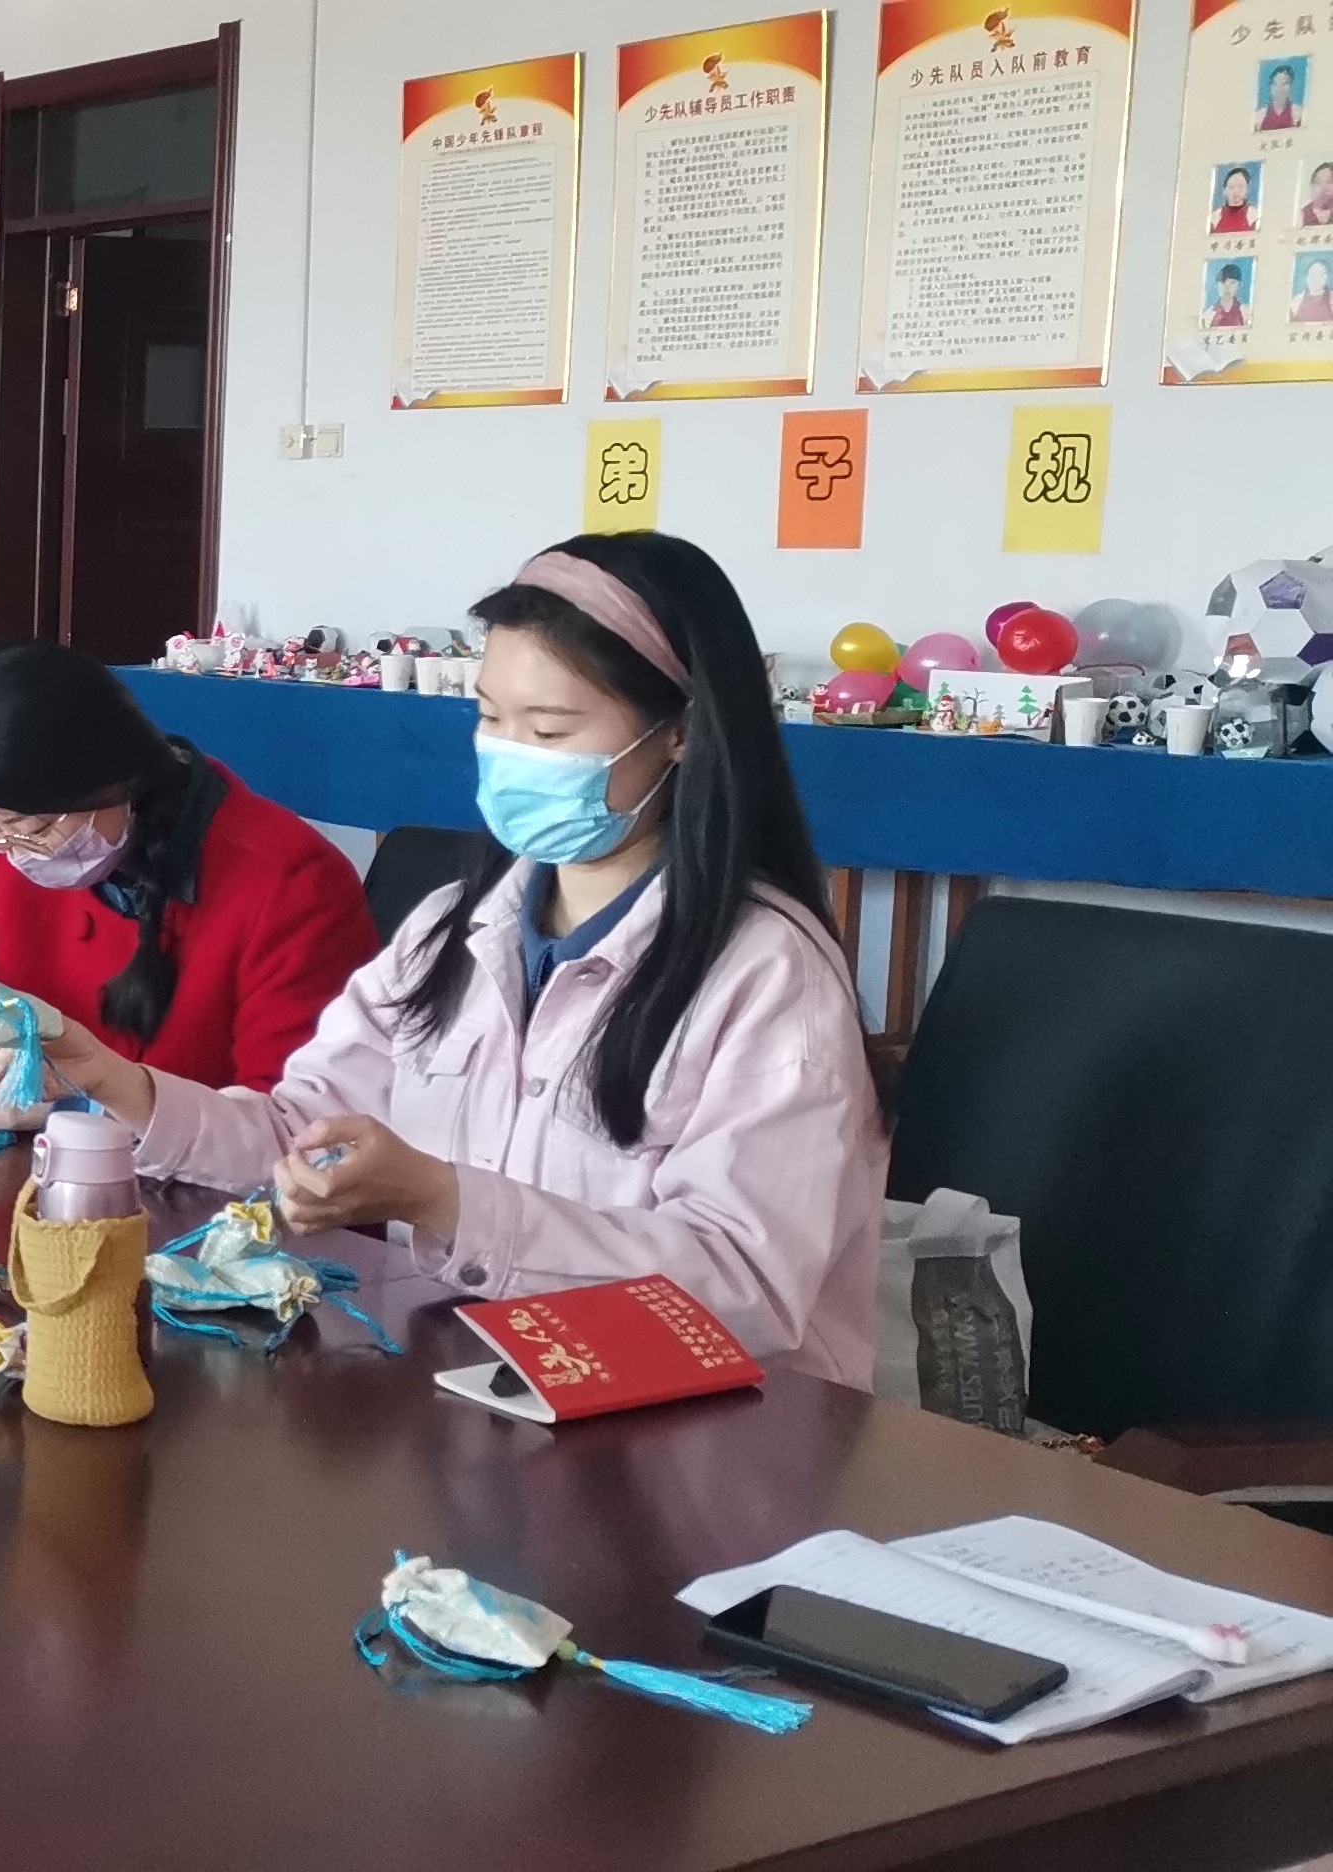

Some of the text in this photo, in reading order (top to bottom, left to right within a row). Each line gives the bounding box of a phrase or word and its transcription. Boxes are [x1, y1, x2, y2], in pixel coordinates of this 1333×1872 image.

[910, 45, 1092, 88] 少先队员入队前教育
[644, 86, 796, 124] 少先队辅导员工作职责
[432, 122, 544, 150] 中国少年先锋队章程
[598, 441, 648, 504] 弟
[795, 435, 853, 501] 子
[1022, 431, 1092, 504] 规
